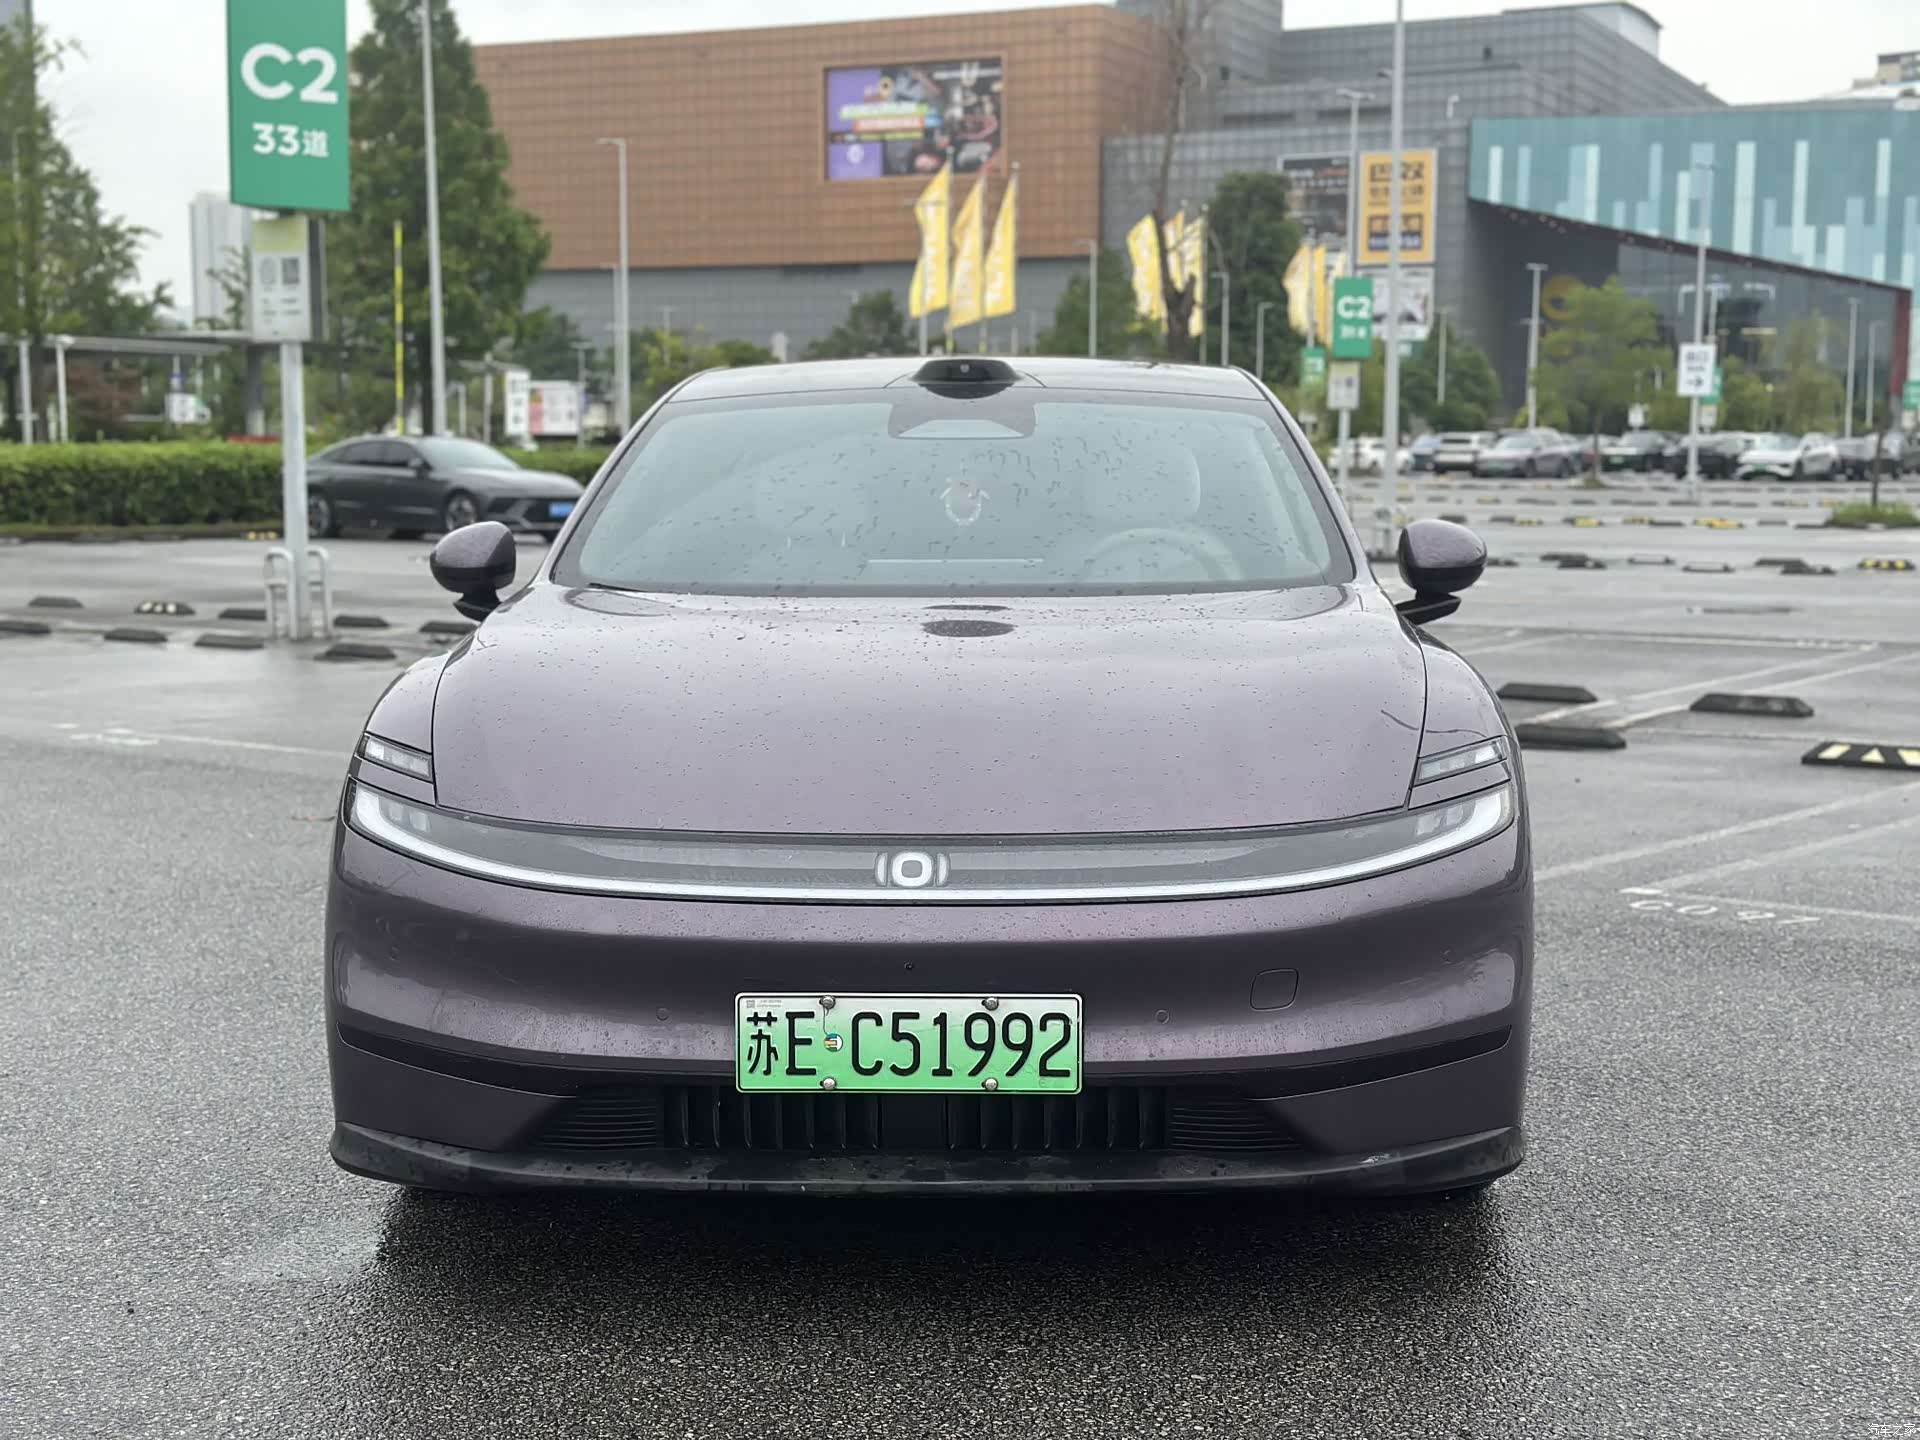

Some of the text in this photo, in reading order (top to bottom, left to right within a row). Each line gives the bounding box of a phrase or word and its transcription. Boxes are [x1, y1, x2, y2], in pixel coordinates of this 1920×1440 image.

[241, 42, 338, 104] C2
[252, 123, 329, 158] 33道
[1336, 295, 1371, 320] C2
[747, 1011, 1073, 1077] 苏E C51992
